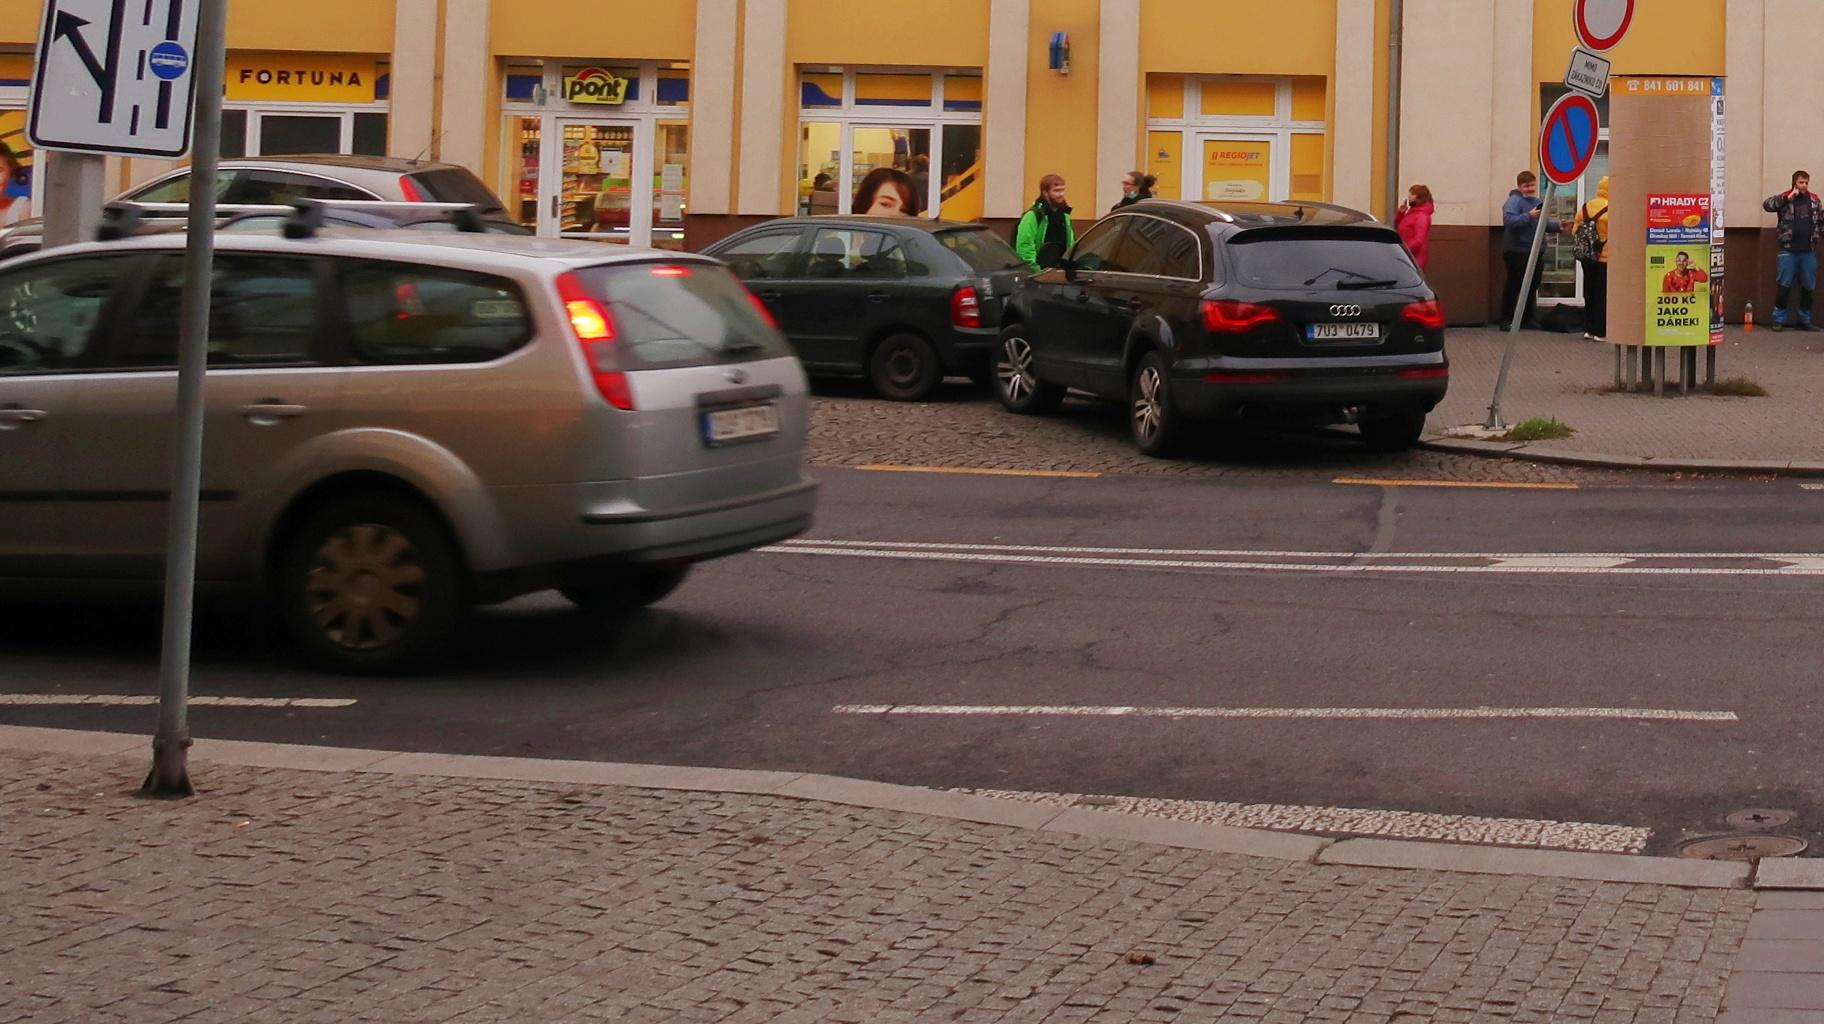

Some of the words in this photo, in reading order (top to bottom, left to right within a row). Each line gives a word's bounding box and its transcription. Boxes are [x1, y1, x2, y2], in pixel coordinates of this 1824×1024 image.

[239, 69, 361, 86] FORTUNA
[568, 79, 622, 101] pont
[1643, 79, 1661, 91] 841
[1687, 80, 1704, 92] 841
[1661, 197, 1697, 206] HRADY
[1698, 197, 1709, 206] CZ
[1657, 296, 1678, 305] 200
[1681, 294, 1696, 305] KČ
[1657, 307, 1689, 316] JAKO
[1657, 316, 1699, 327] DÁREK!
[1316, 323, 1338, 337] 7U3
[1346, 323, 1374, 336] 0479
